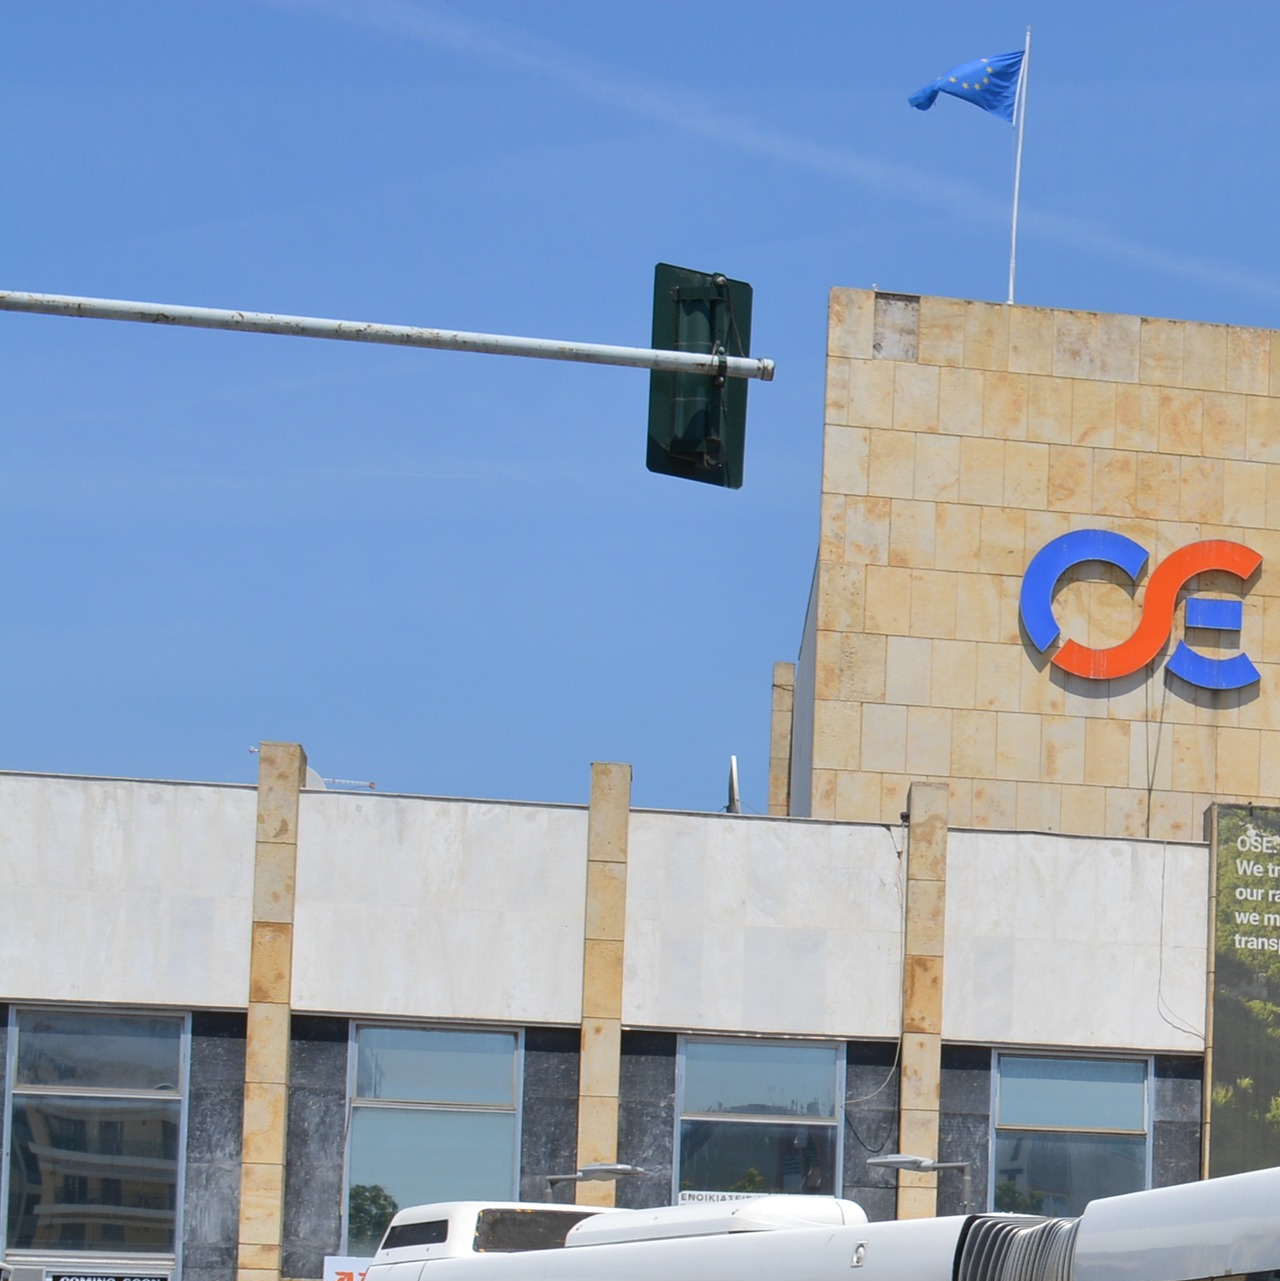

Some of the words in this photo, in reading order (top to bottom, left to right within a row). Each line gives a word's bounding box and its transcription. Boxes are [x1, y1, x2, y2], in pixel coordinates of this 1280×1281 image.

[1237, 836, 1277, 853] OSE.
[1236, 859, 1263, 876] We
[1235, 887, 1264, 901] our
[1235, 912, 1260, 925] we
